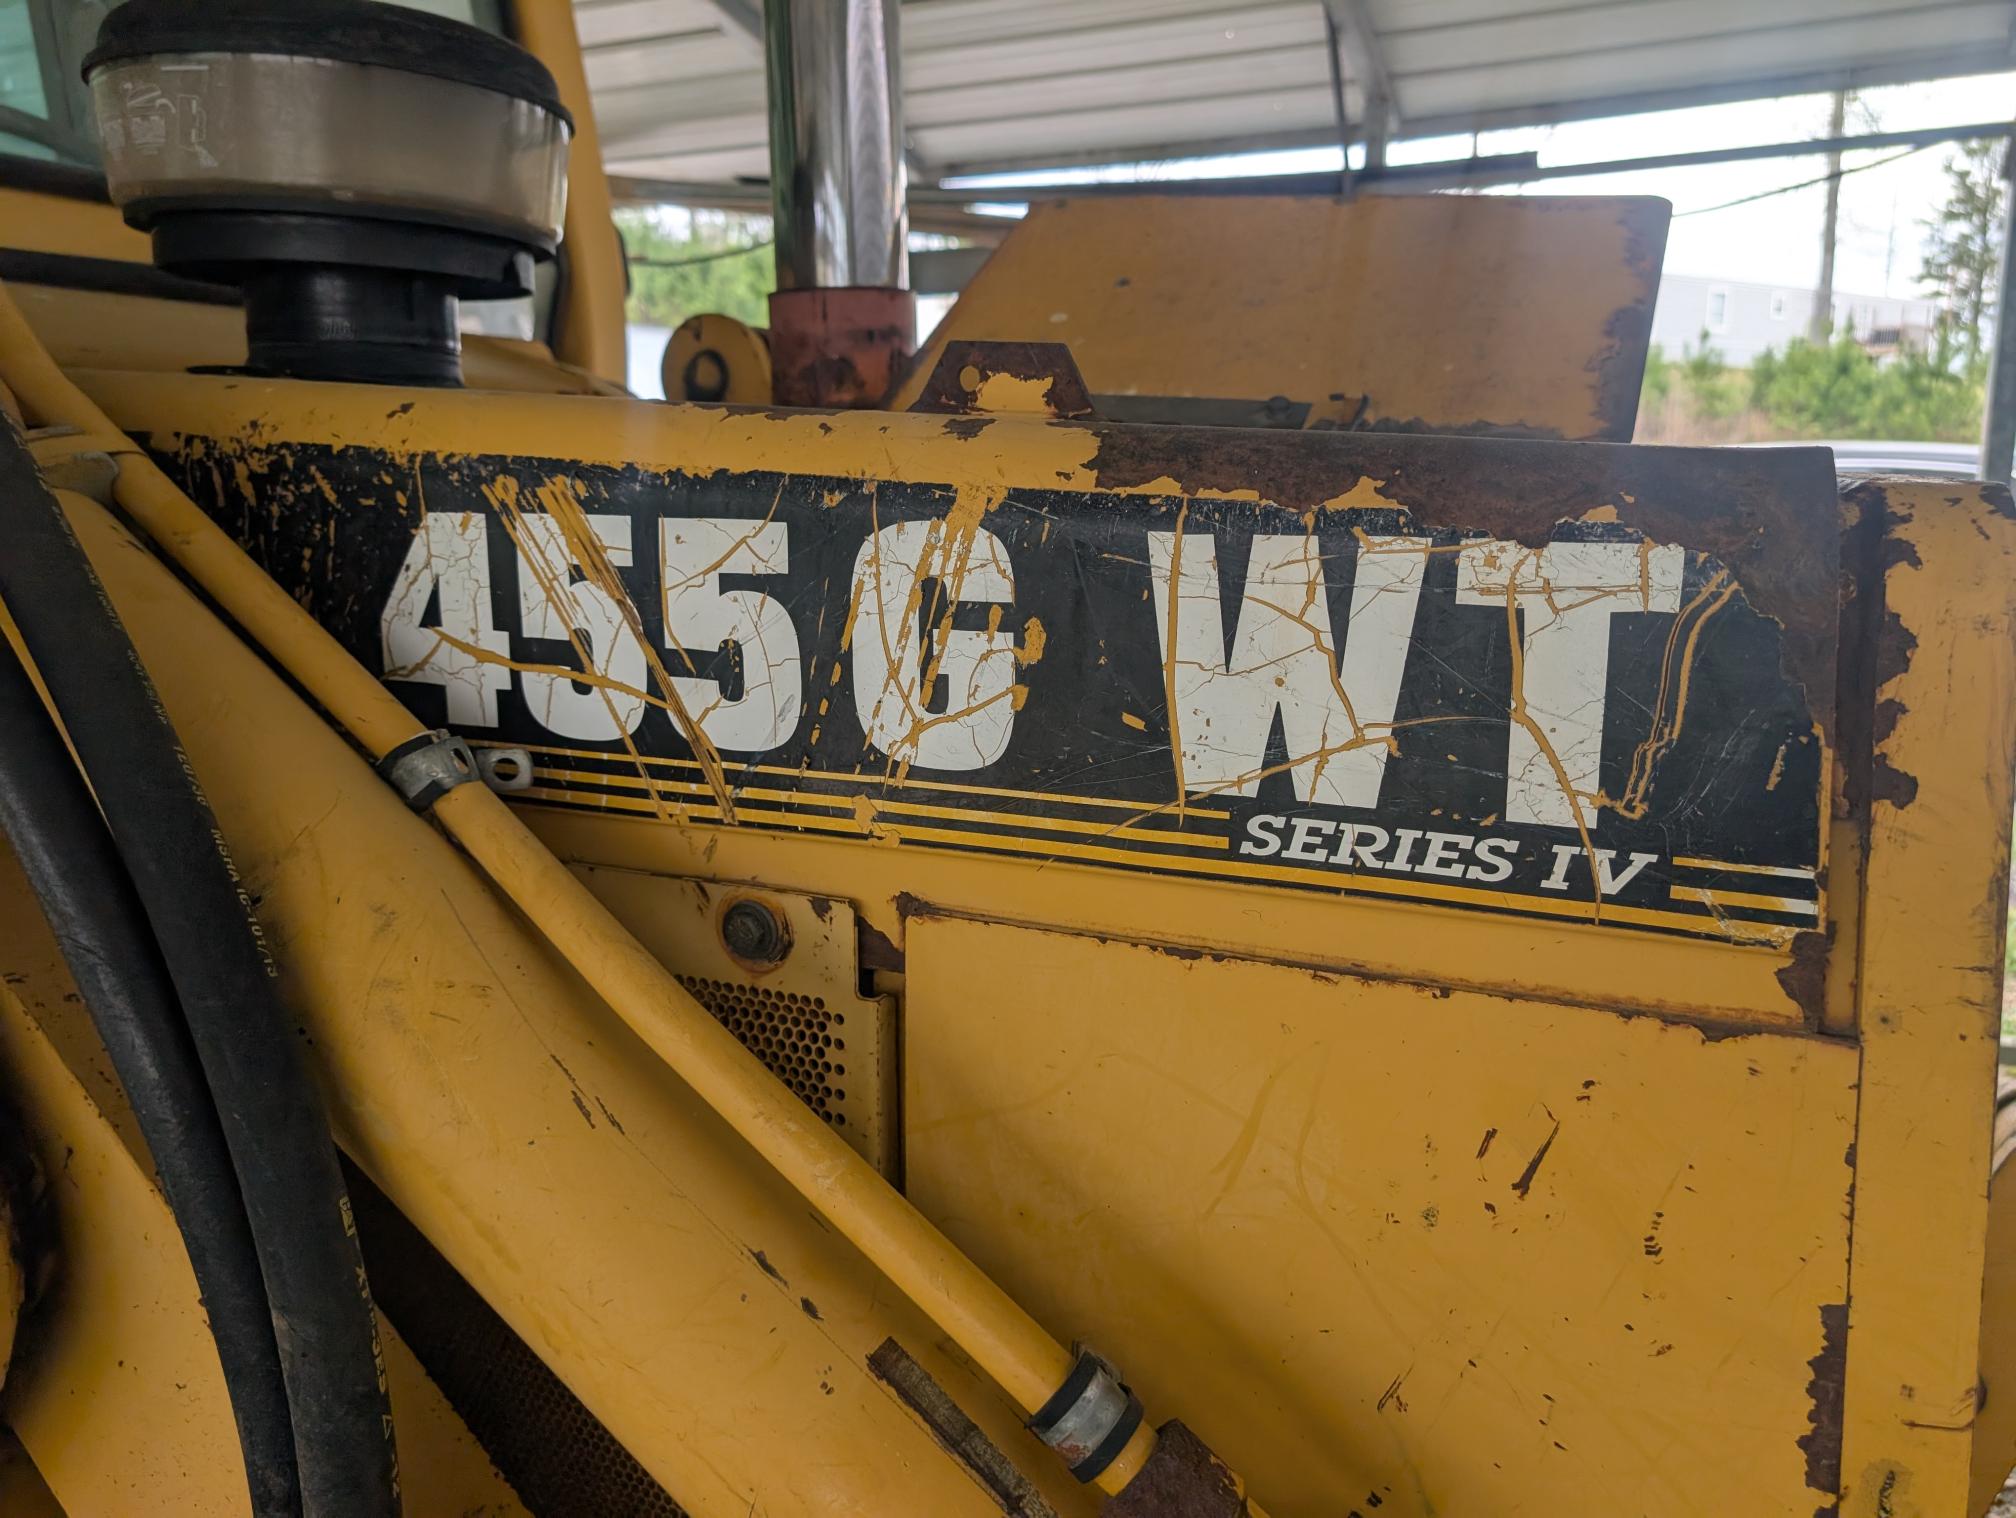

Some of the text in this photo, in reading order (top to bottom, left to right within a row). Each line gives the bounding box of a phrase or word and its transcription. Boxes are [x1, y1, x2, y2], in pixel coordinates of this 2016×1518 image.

[1147, 530, 1686, 829] WT
[1239, 813, 1659, 896] SERIES IV
